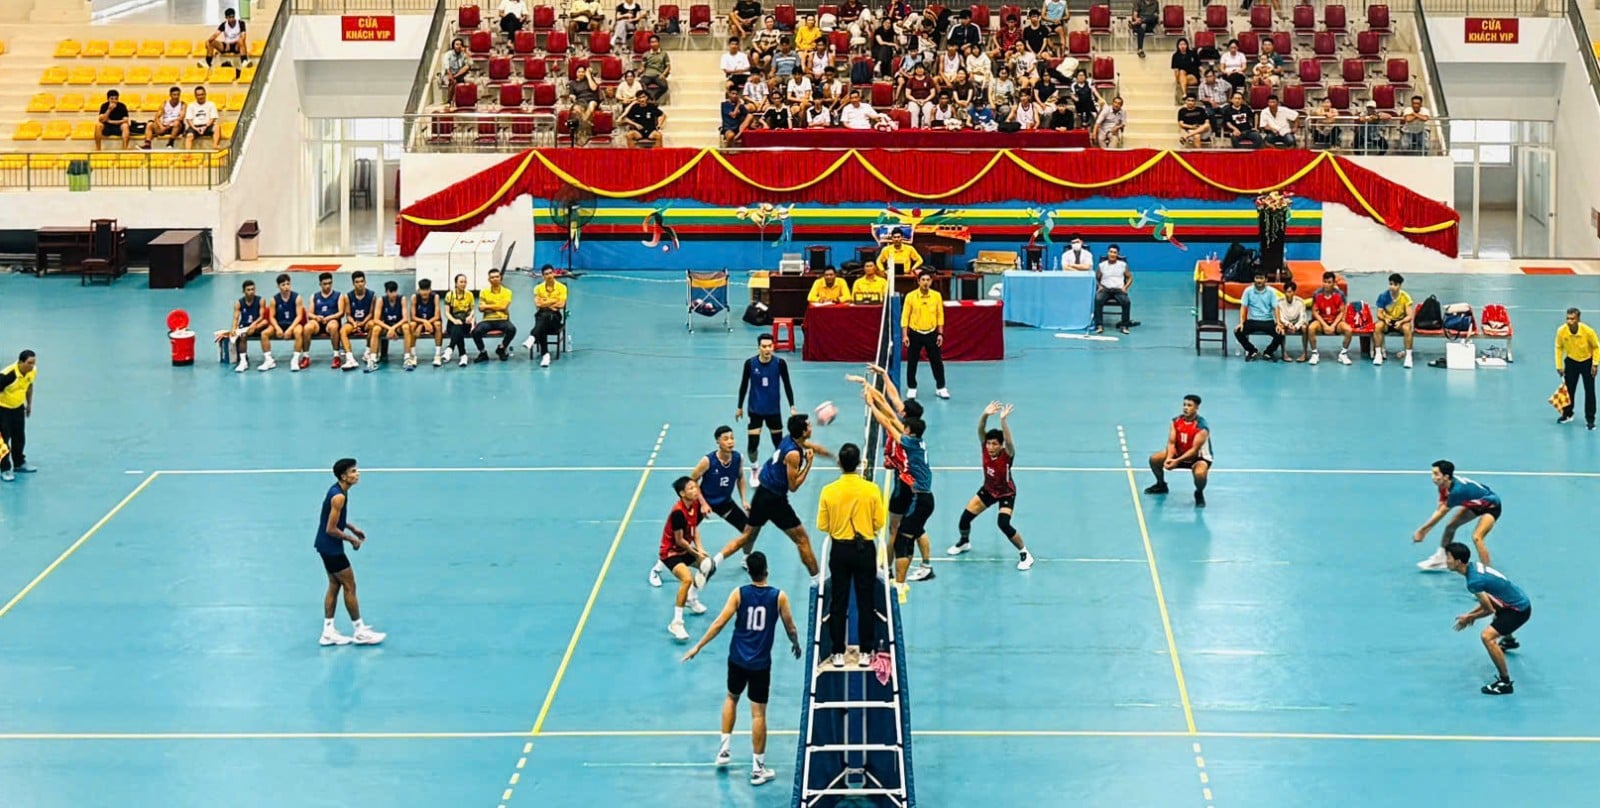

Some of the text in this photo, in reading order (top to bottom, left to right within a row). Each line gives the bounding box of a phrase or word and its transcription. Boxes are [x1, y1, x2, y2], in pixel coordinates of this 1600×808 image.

[346, 29, 391, 39] KHÁCH VIP
[1469, 31, 1514, 41] KHÁCH VIP
[354, 309, 365, 318] 25
[720, 476, 729, 487] 12
[746, 606, 766, 631] 10
